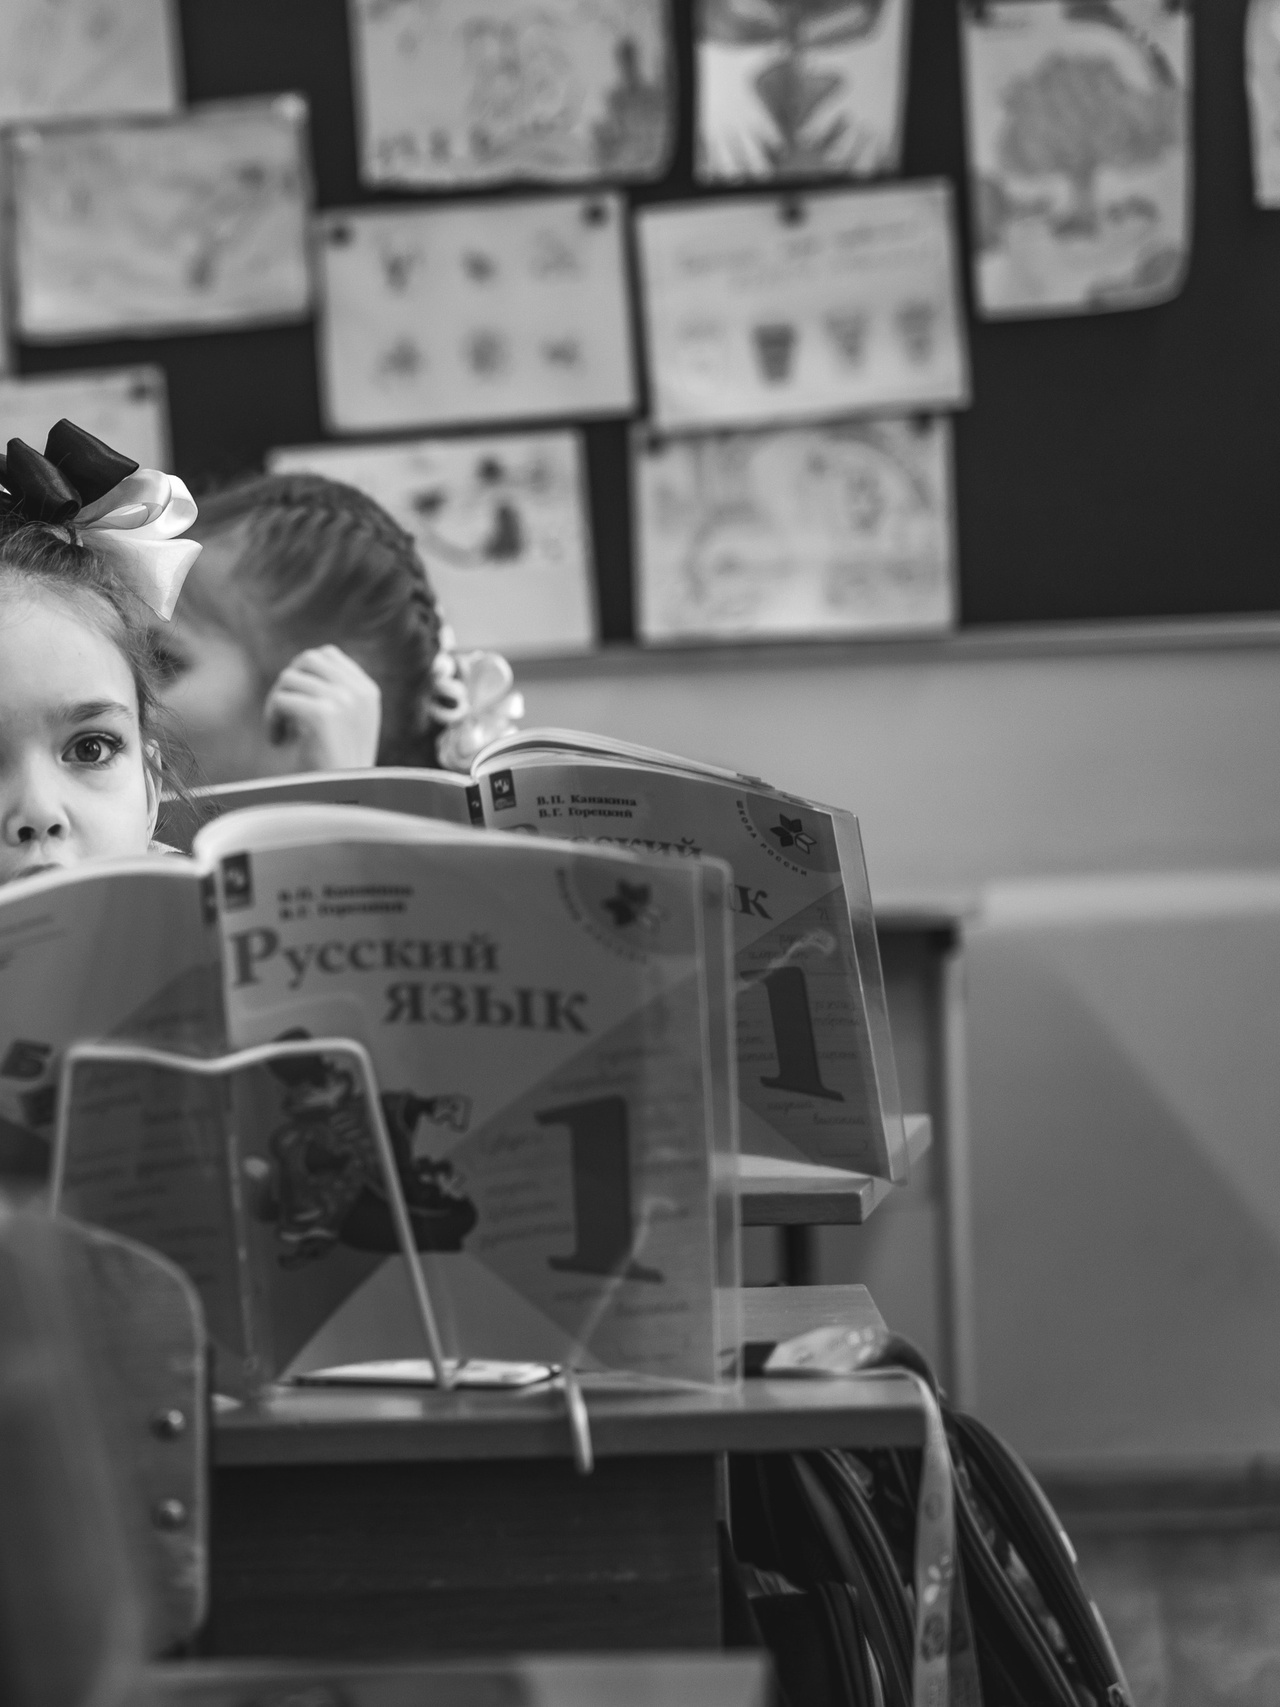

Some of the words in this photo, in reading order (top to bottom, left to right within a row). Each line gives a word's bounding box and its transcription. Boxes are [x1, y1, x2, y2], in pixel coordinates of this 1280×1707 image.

[567, 806, 634, 819] Горецкий
[569, 794, 638, 807] Канакина
[735, 799, 757, 839] ШКОЛА
[760, 842, 808, 877] РОССИИ
[229, 926, 499, 992] Русский
[739, 966, 846, 1104] 1
[533, 1093, 668, 1285] 1
